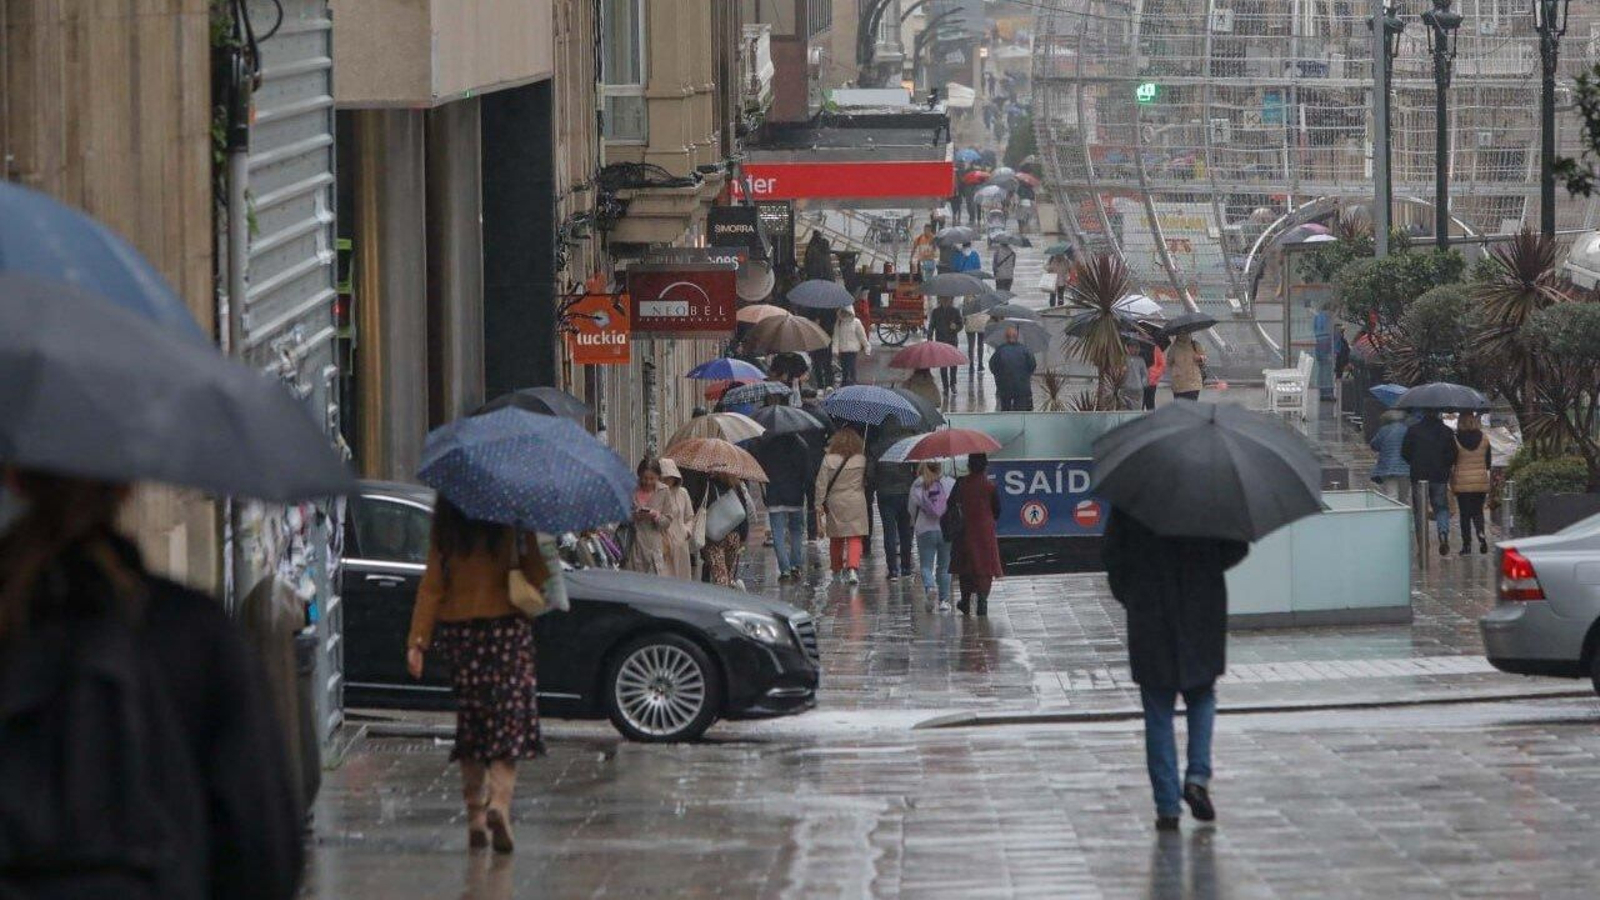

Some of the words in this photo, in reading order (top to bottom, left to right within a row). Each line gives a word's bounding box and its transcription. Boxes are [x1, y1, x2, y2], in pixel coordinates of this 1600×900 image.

[714, 224, 755, 233] SIMORRA
[651, 305, 726, 316] NEOBEL
[577, 330, 626, 345] luckia
[1004, 463, 1091, 494] SAÍD
